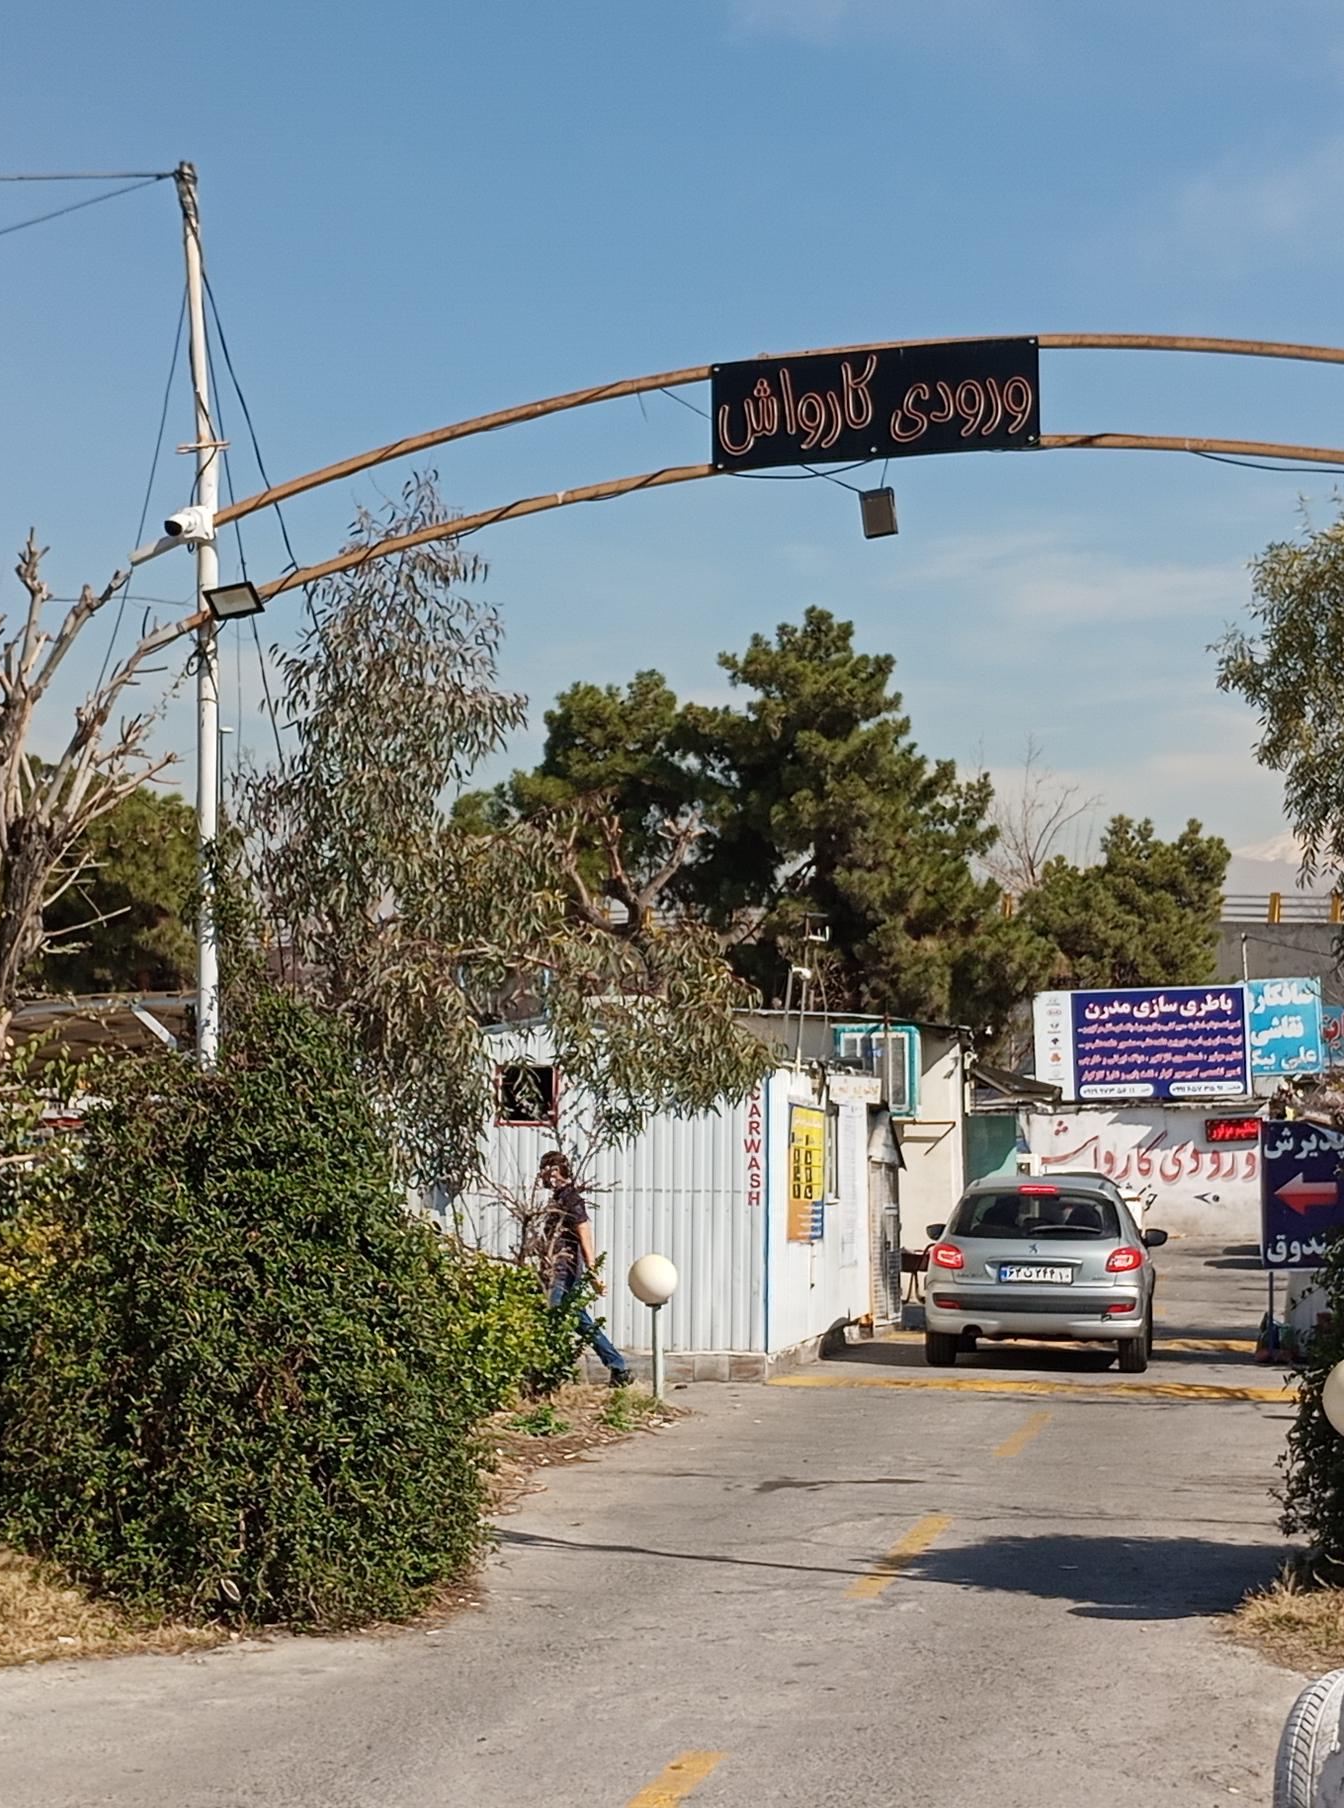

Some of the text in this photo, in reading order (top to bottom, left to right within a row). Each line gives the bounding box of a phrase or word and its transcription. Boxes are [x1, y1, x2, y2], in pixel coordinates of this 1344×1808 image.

[718, 354, 1032, 456] ورودی کارواش
[1085, 993, 1232, 1020] باطری سازی مدرن
[743, 1083, 762, 1206] CARWASH
[1159, 1139, 1259, 1184] ورودی
[1266, 1232, 1328, 1263] ندوق
